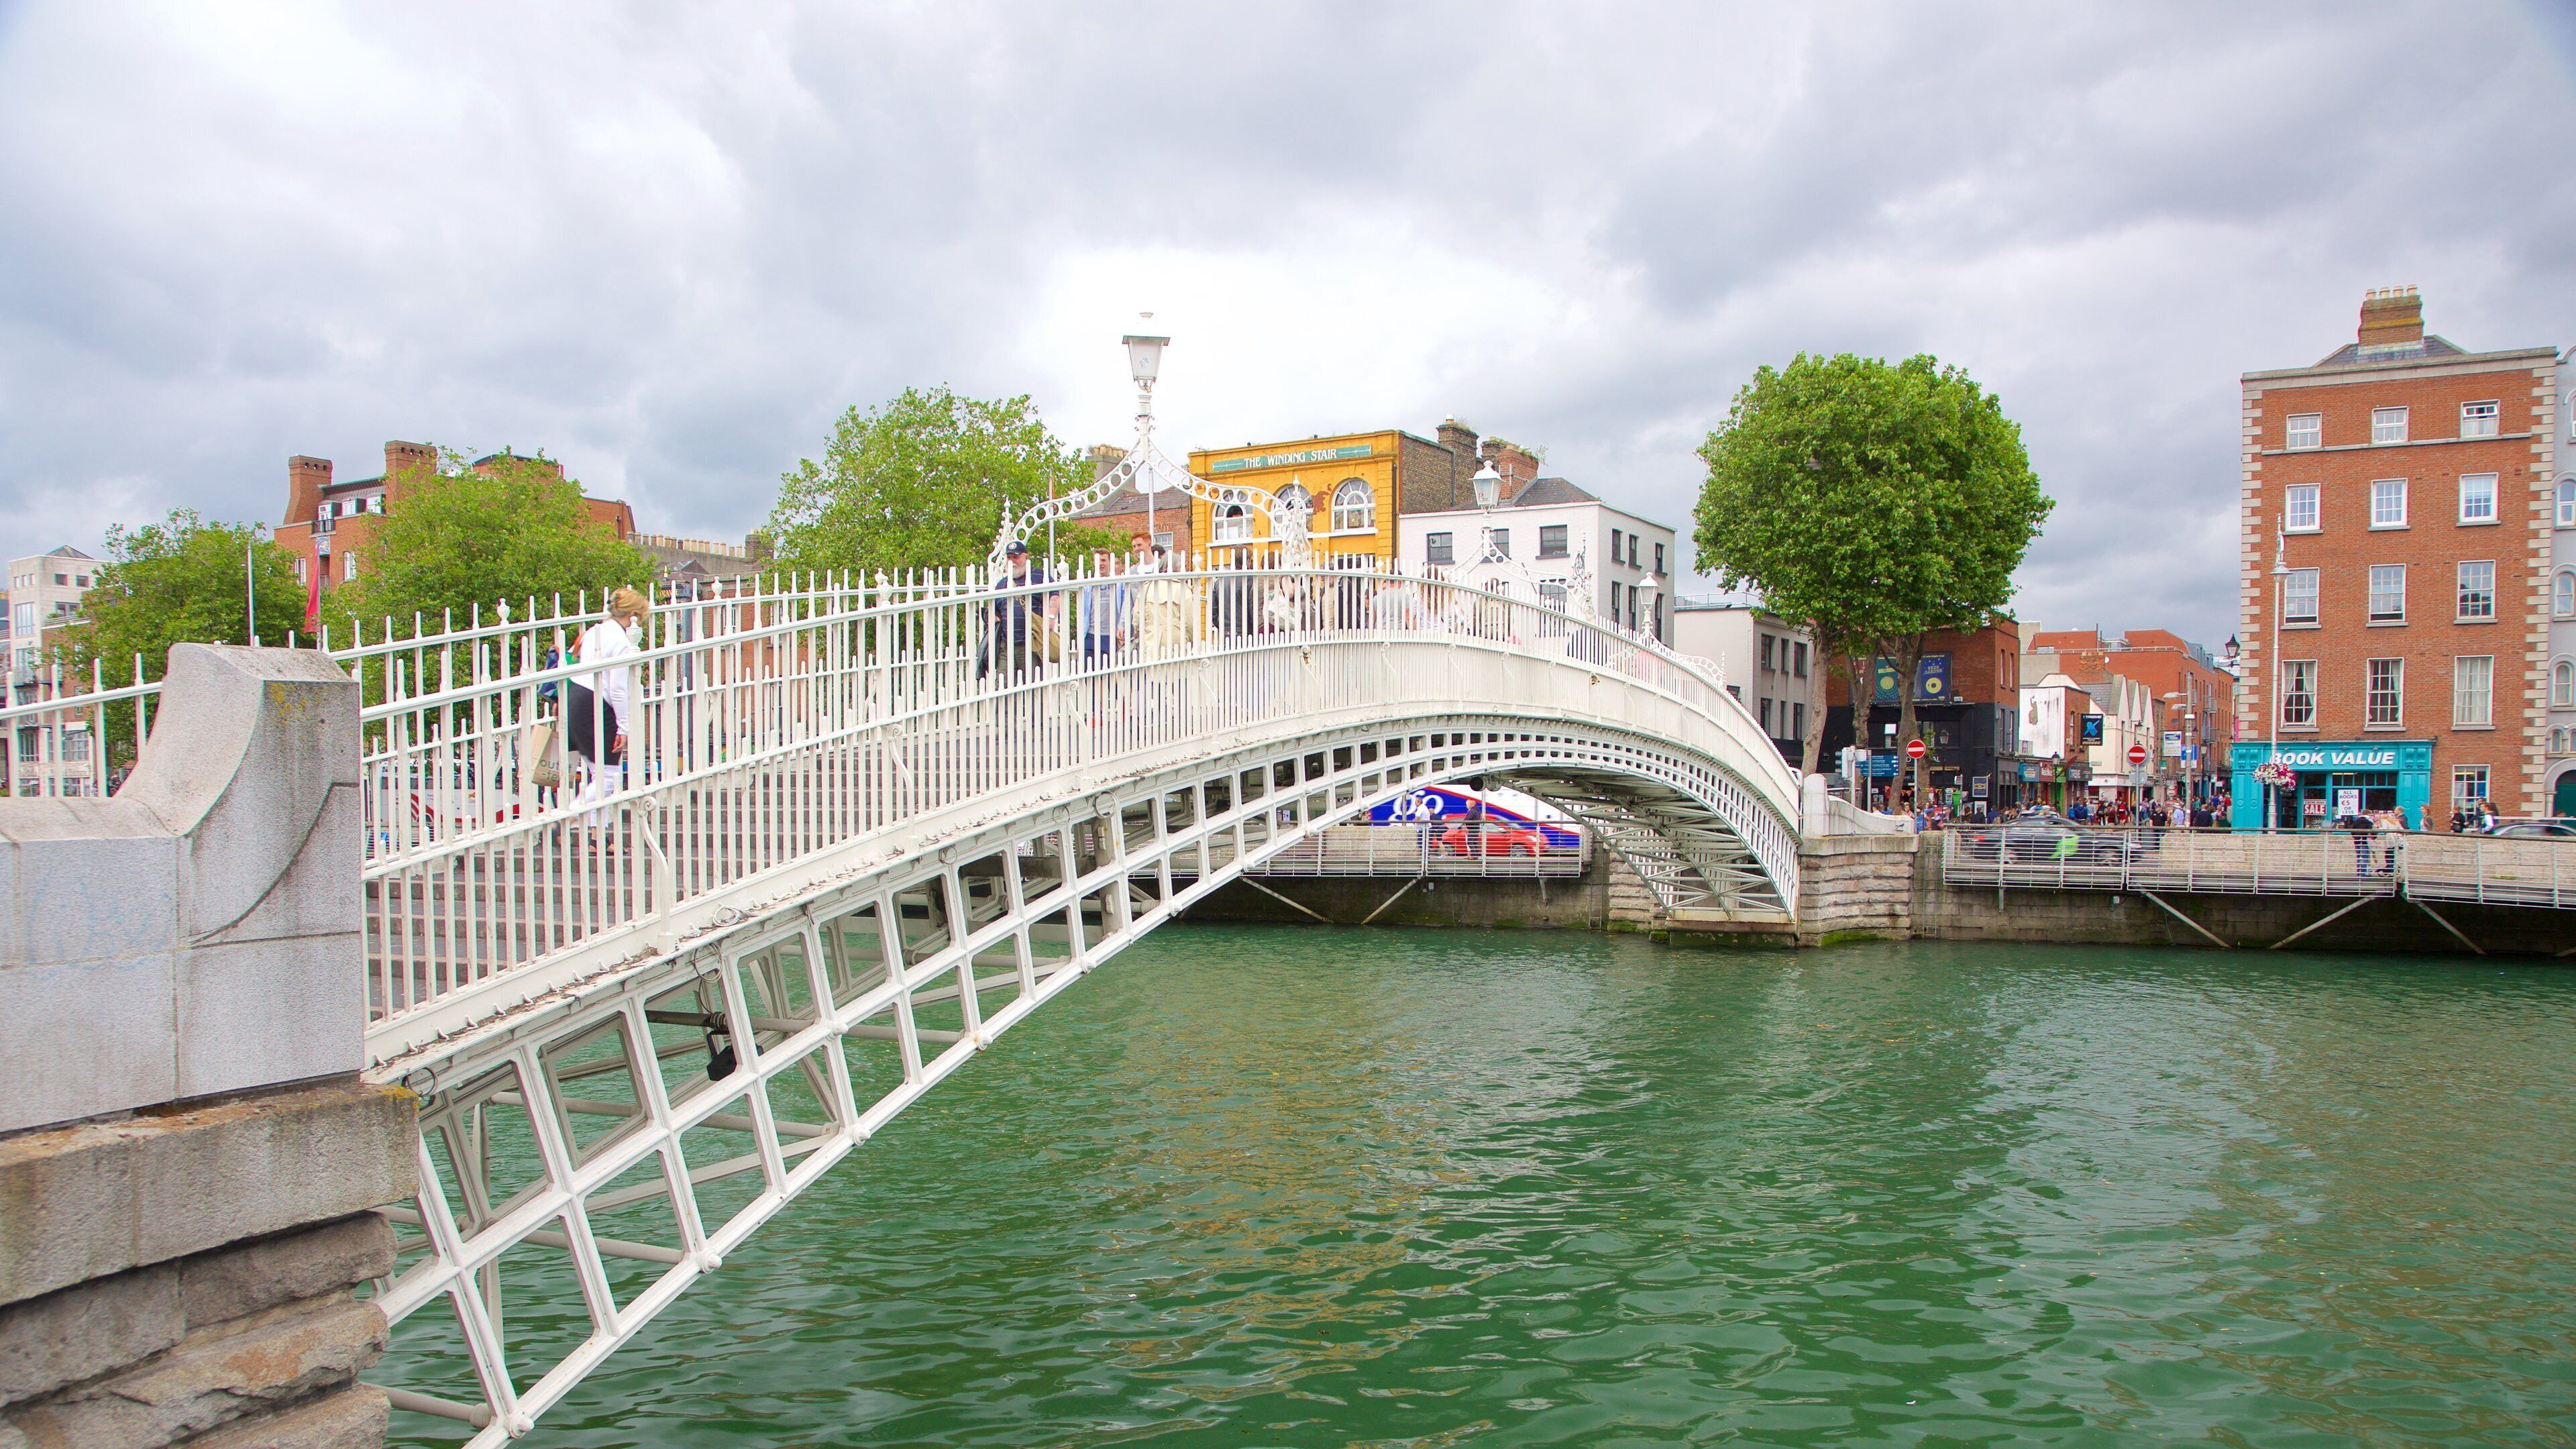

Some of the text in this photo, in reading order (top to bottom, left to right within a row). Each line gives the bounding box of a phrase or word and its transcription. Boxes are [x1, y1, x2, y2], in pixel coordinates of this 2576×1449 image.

[1244, 448, 1337, 468] THE WINDING STAIR
[2269, 752, 2396, 765] BOOK VALUE
[2304, 804, 2325, 814] SALE
